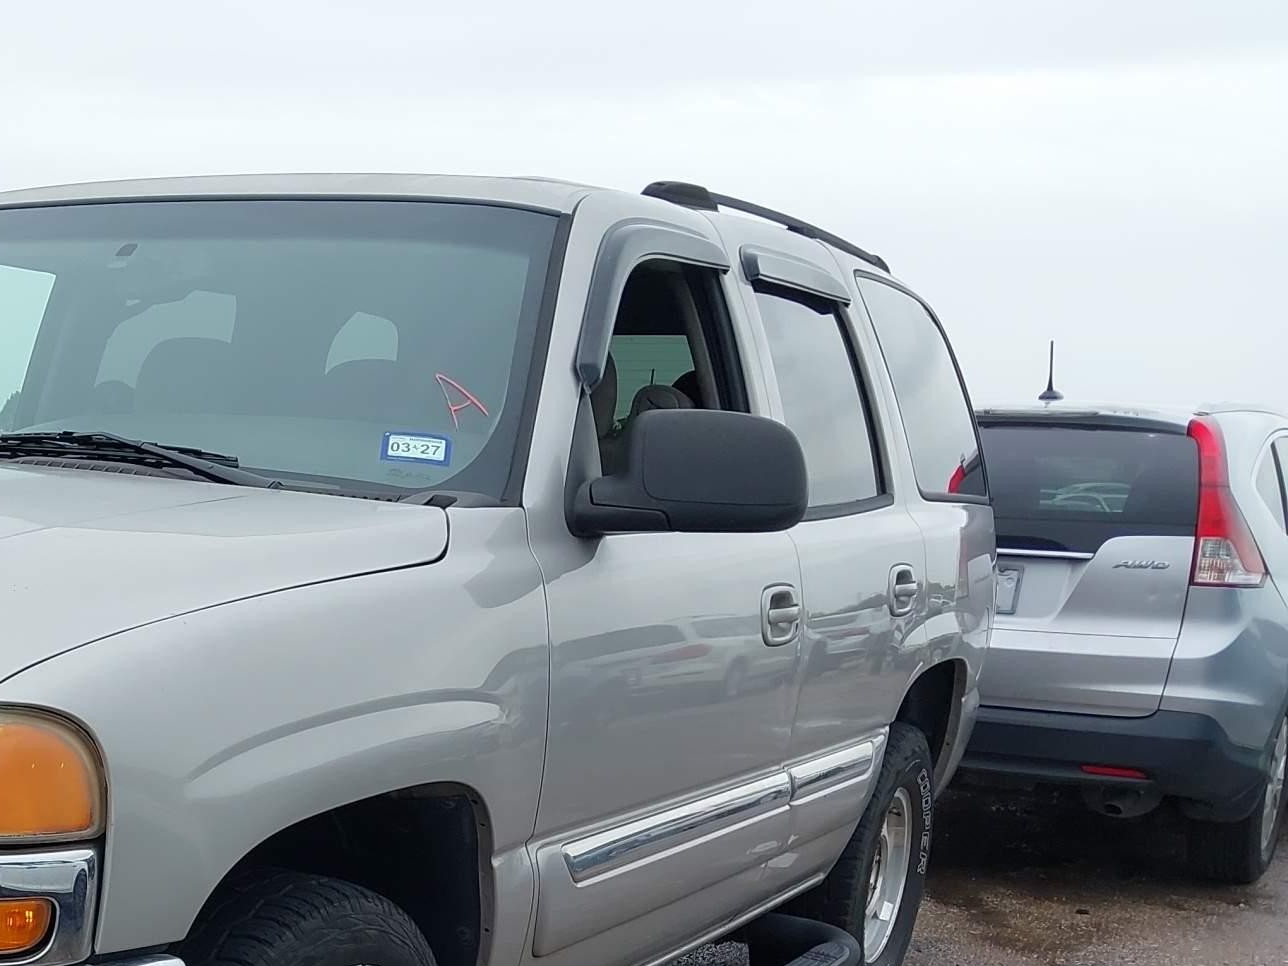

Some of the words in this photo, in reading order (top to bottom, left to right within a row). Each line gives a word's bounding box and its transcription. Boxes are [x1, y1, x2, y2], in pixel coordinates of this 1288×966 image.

[435, 373, 489, 431] A
[390, 441, 411, 454] 03
[420, 443, 441, 456] 27
[1111, 559, 1170, 570] AWD
[917, 768, 932, 874] COOPER
